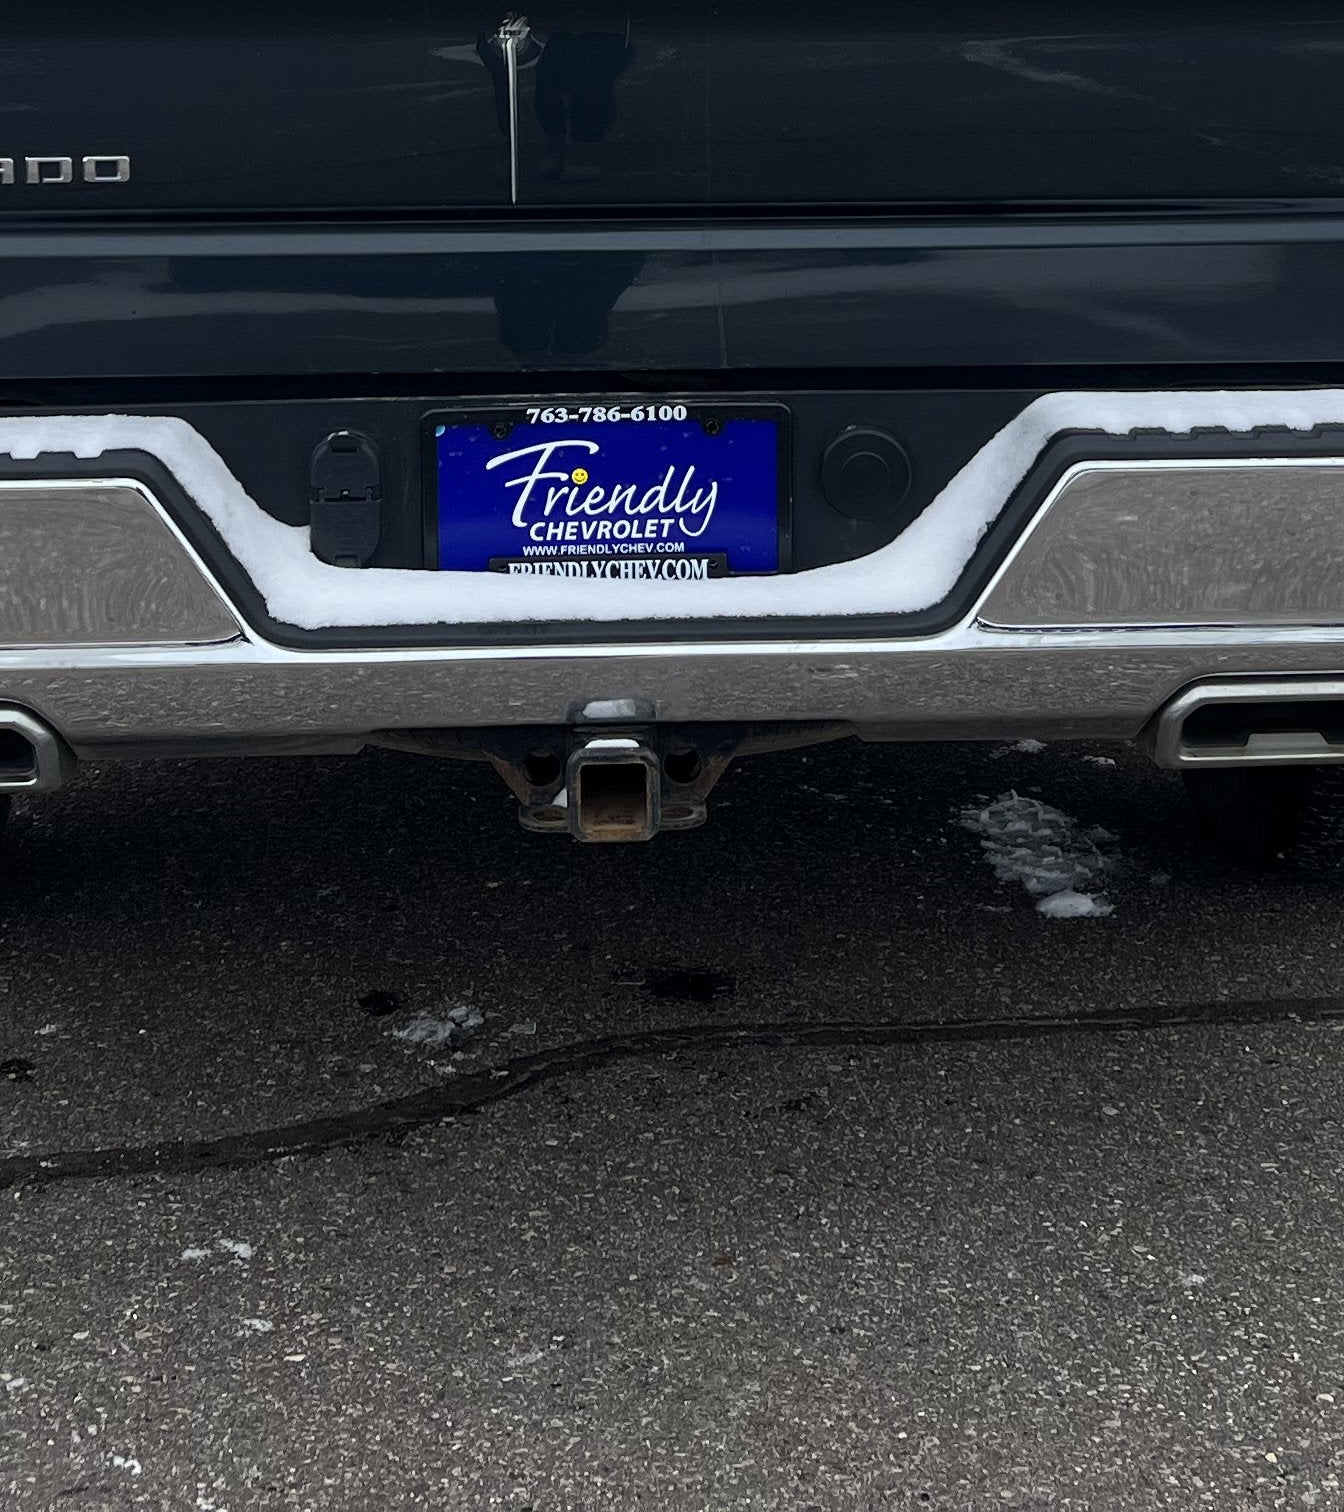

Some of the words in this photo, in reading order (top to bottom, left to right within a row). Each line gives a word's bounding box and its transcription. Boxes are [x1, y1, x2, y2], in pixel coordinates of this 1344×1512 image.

[526, 405, 688, 424] 763-786-6100
[485, 439, 718, 537] Friendly
[529, 518, 675, 541] CHEVROLET
[522, 541, 685, 556] WWW.FRIENDLYCHEV.COM
